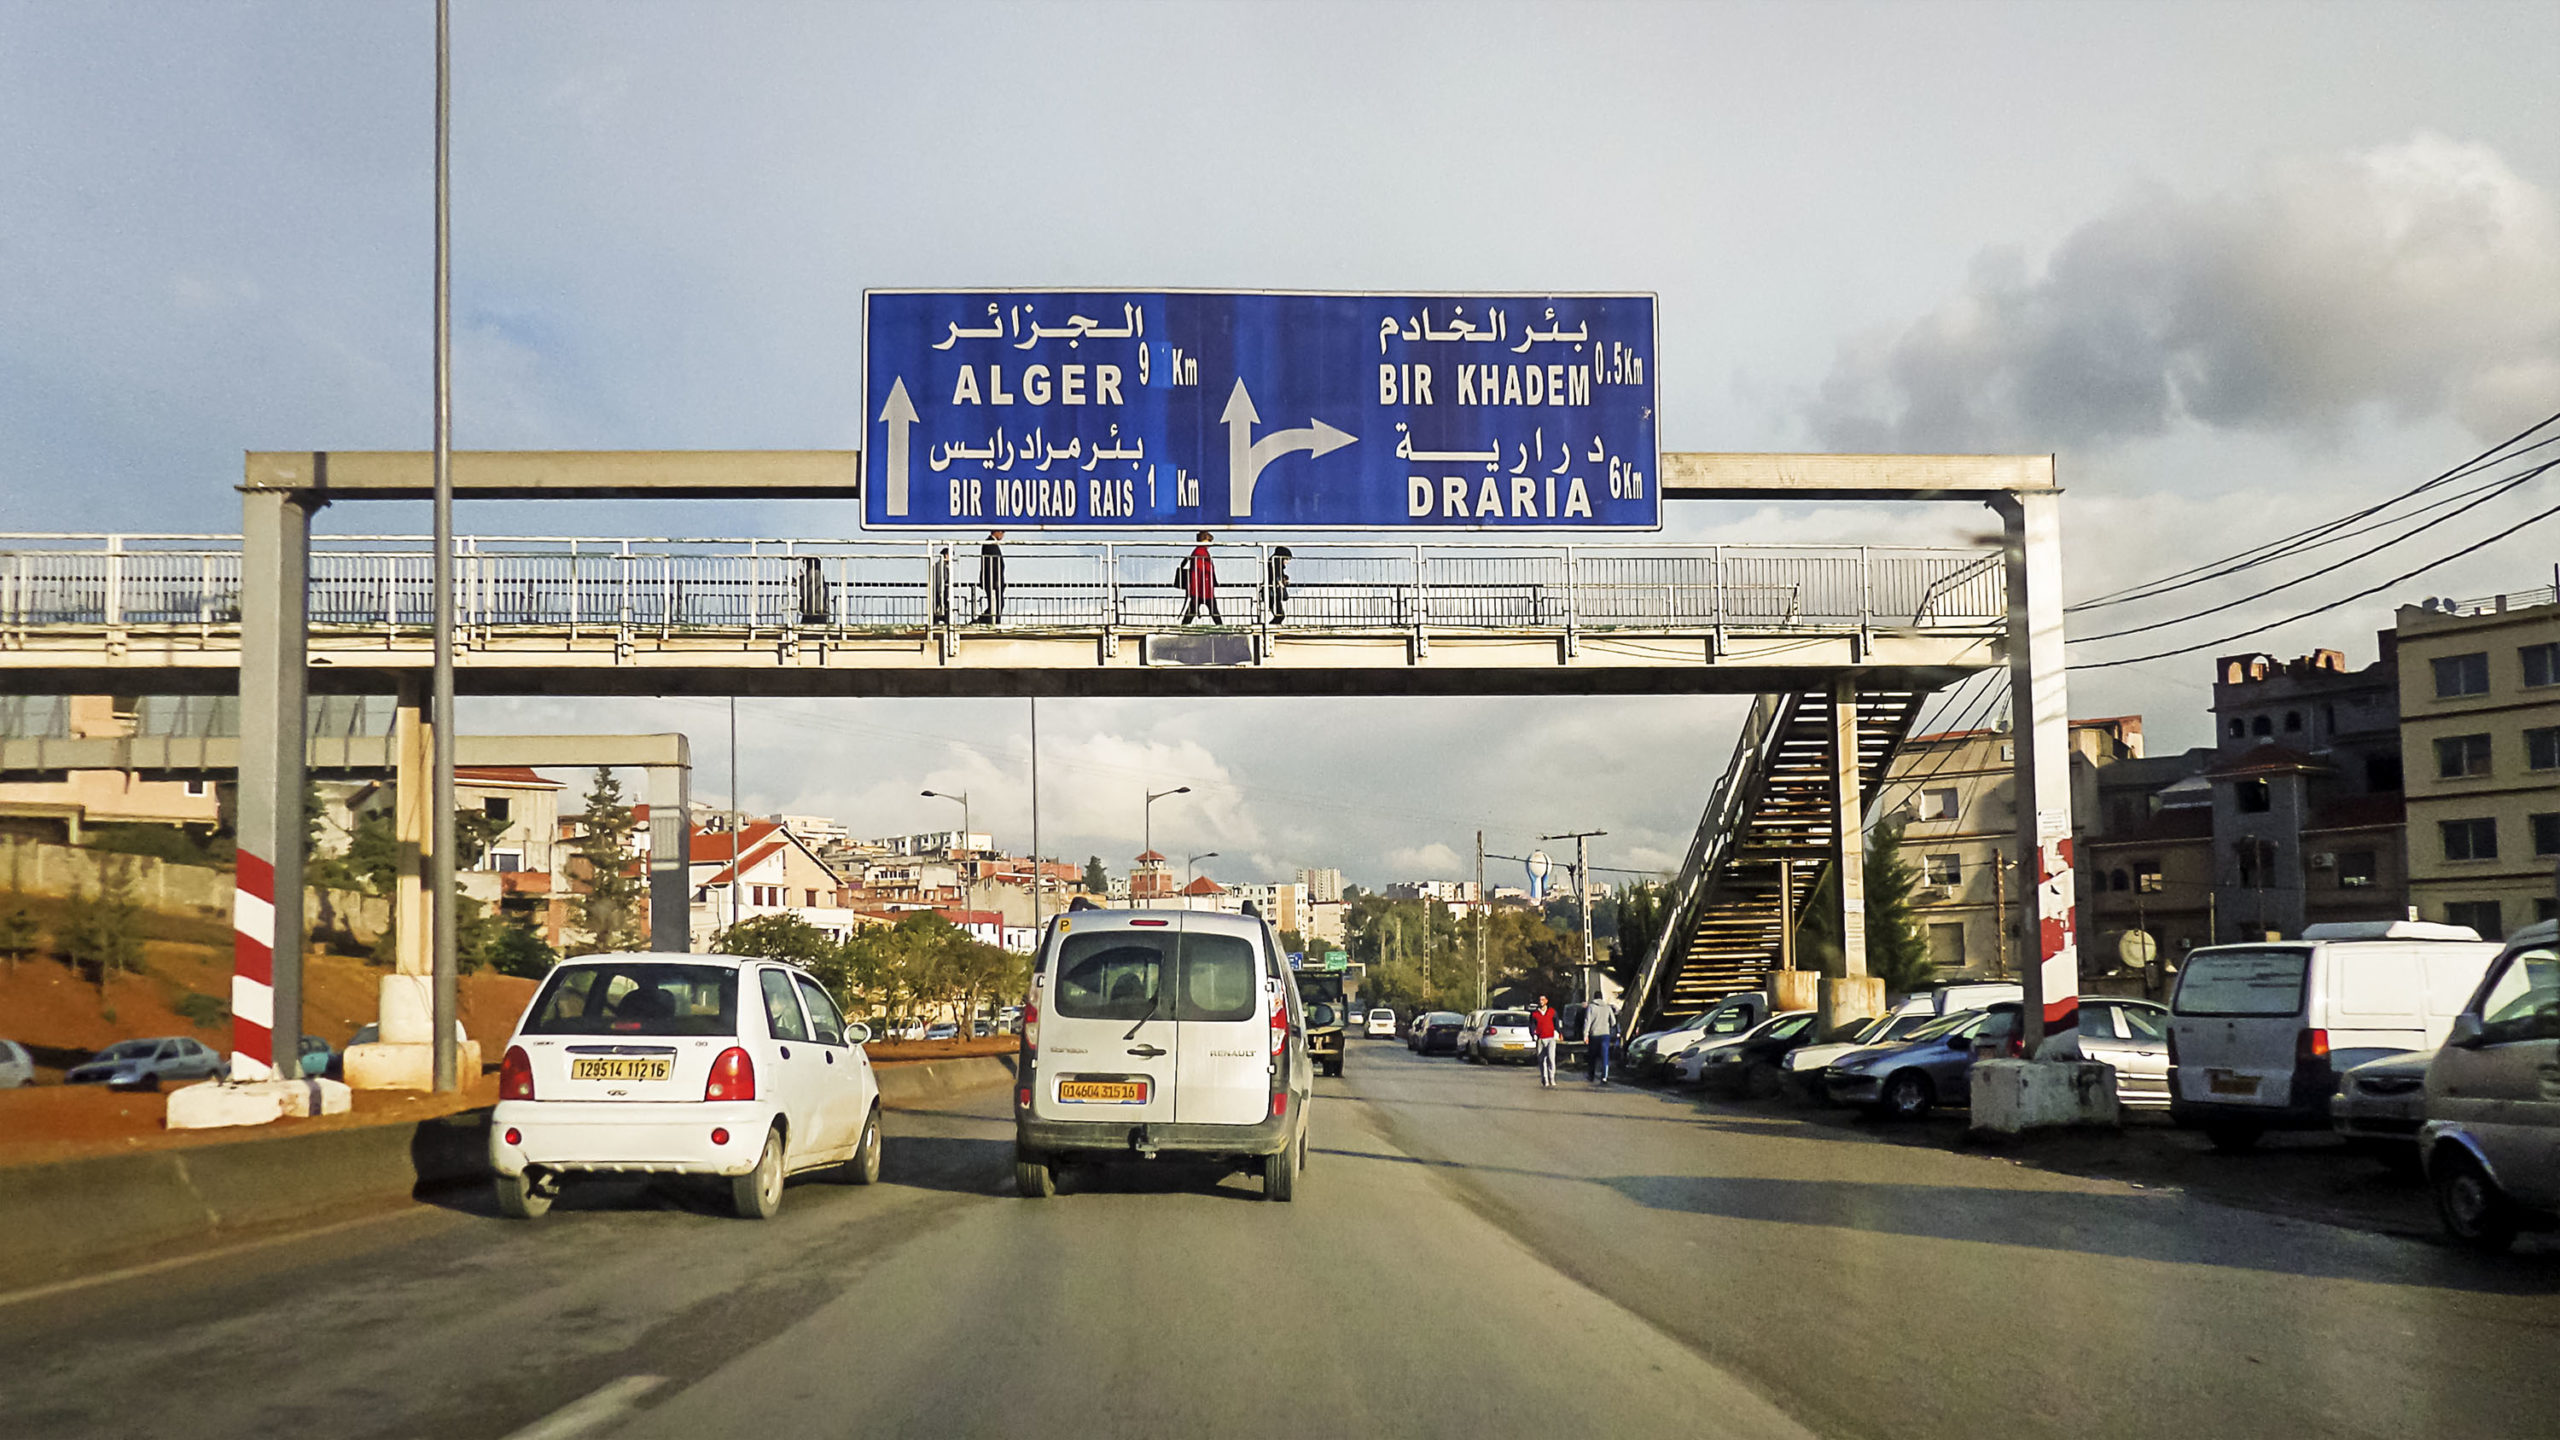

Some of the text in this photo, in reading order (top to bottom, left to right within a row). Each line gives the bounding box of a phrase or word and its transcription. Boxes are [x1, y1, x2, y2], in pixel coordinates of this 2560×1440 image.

[932, 302, 1144, 350] الجزائر
[1379, 305, 1588, 355] بئر الخادم
[952, 364, 1124, 405] ALGER
[1138, 341, 1198, 386] 9 Km
[1379, 363, 1590, 406] BIR KHADEM
[1081, 423, 1144, 471] بئر
[949, 478, 1135, 518] BIR MOURAD RAIS
[1147, 464, 1200, 509] 1 Km
[1408, 475, 1592, 518] DRARIA
[1060, 920, 1069, 931] P
[1209, 1049, 1257, 1058] RENAULT
